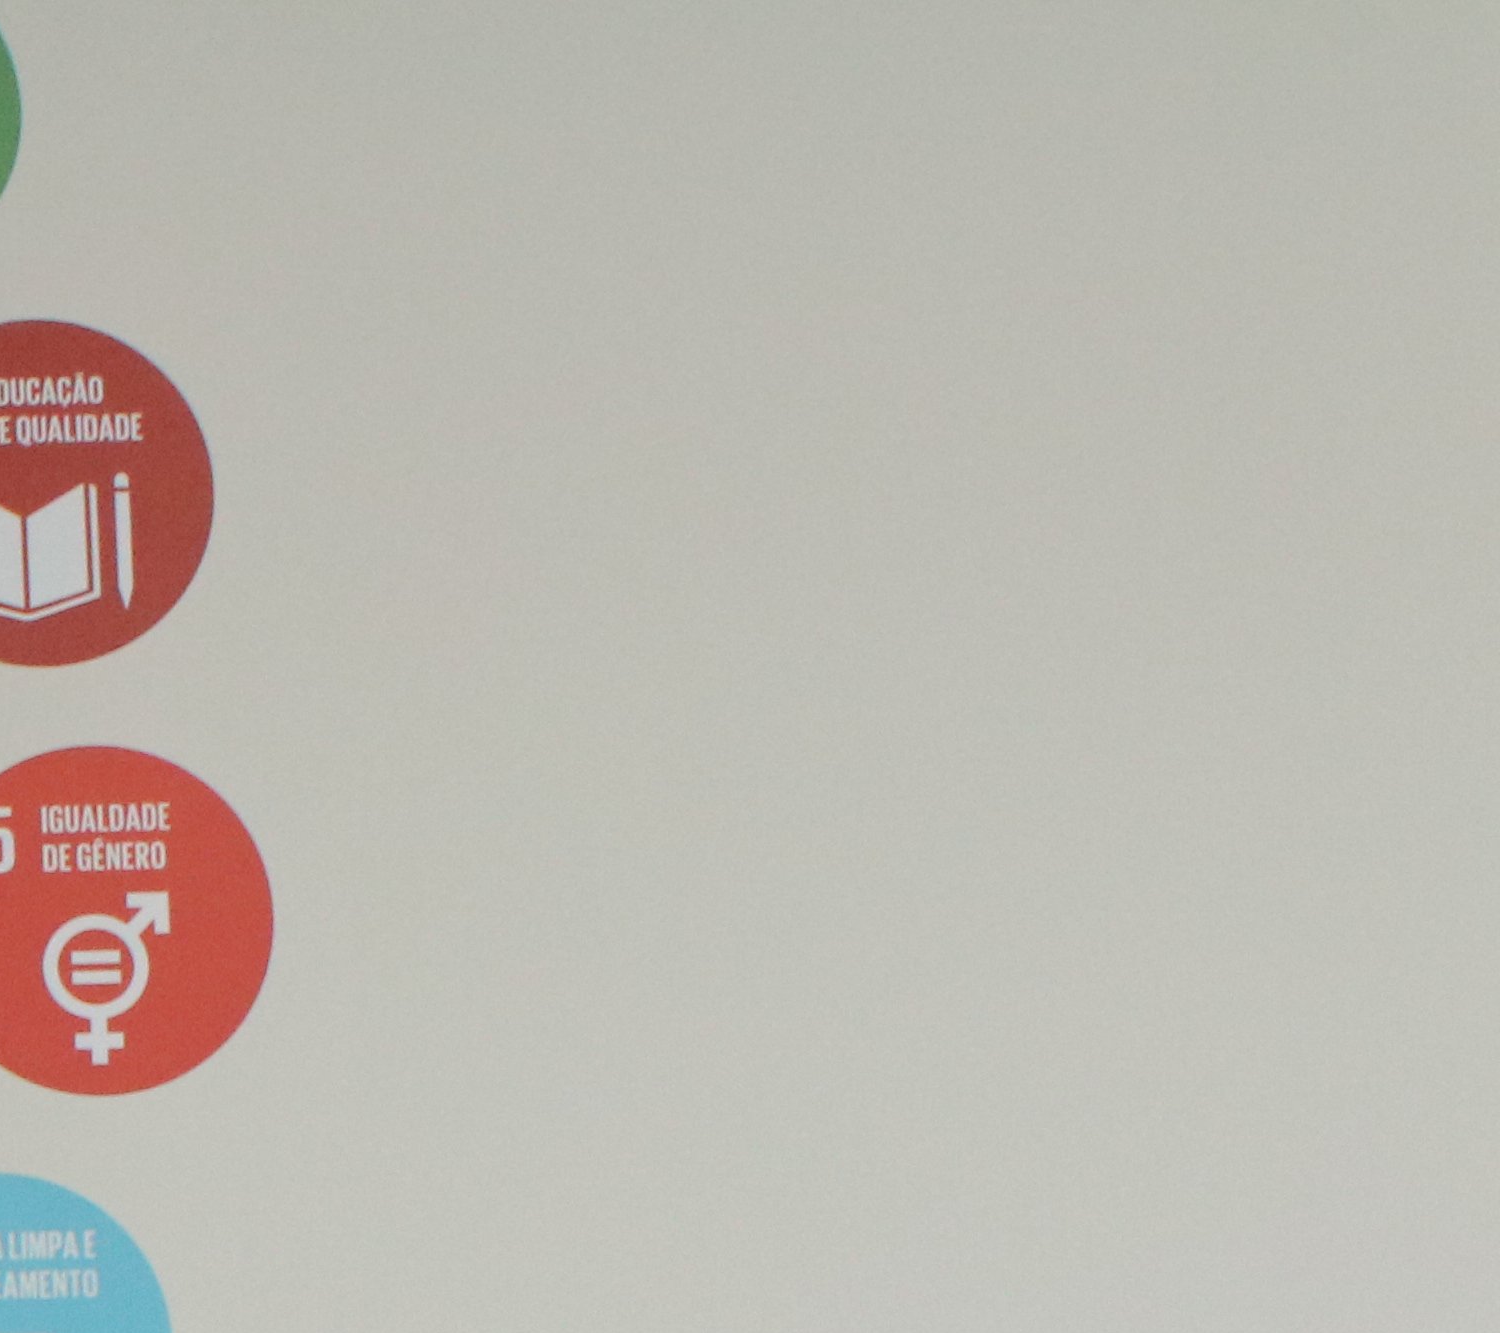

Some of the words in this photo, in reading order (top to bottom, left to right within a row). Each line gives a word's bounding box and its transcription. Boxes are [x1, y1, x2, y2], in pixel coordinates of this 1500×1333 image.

[15, 412, 144, 447] QUALIDADE
[40, 801, 171, 835] IGUALDADE
[42, 843, 72, 874] DE
[76, 837, 167, 872] GÊNERO
[8, 1230, 80, 1261] LIMPA
[84, 1229, 98, 1259] E
